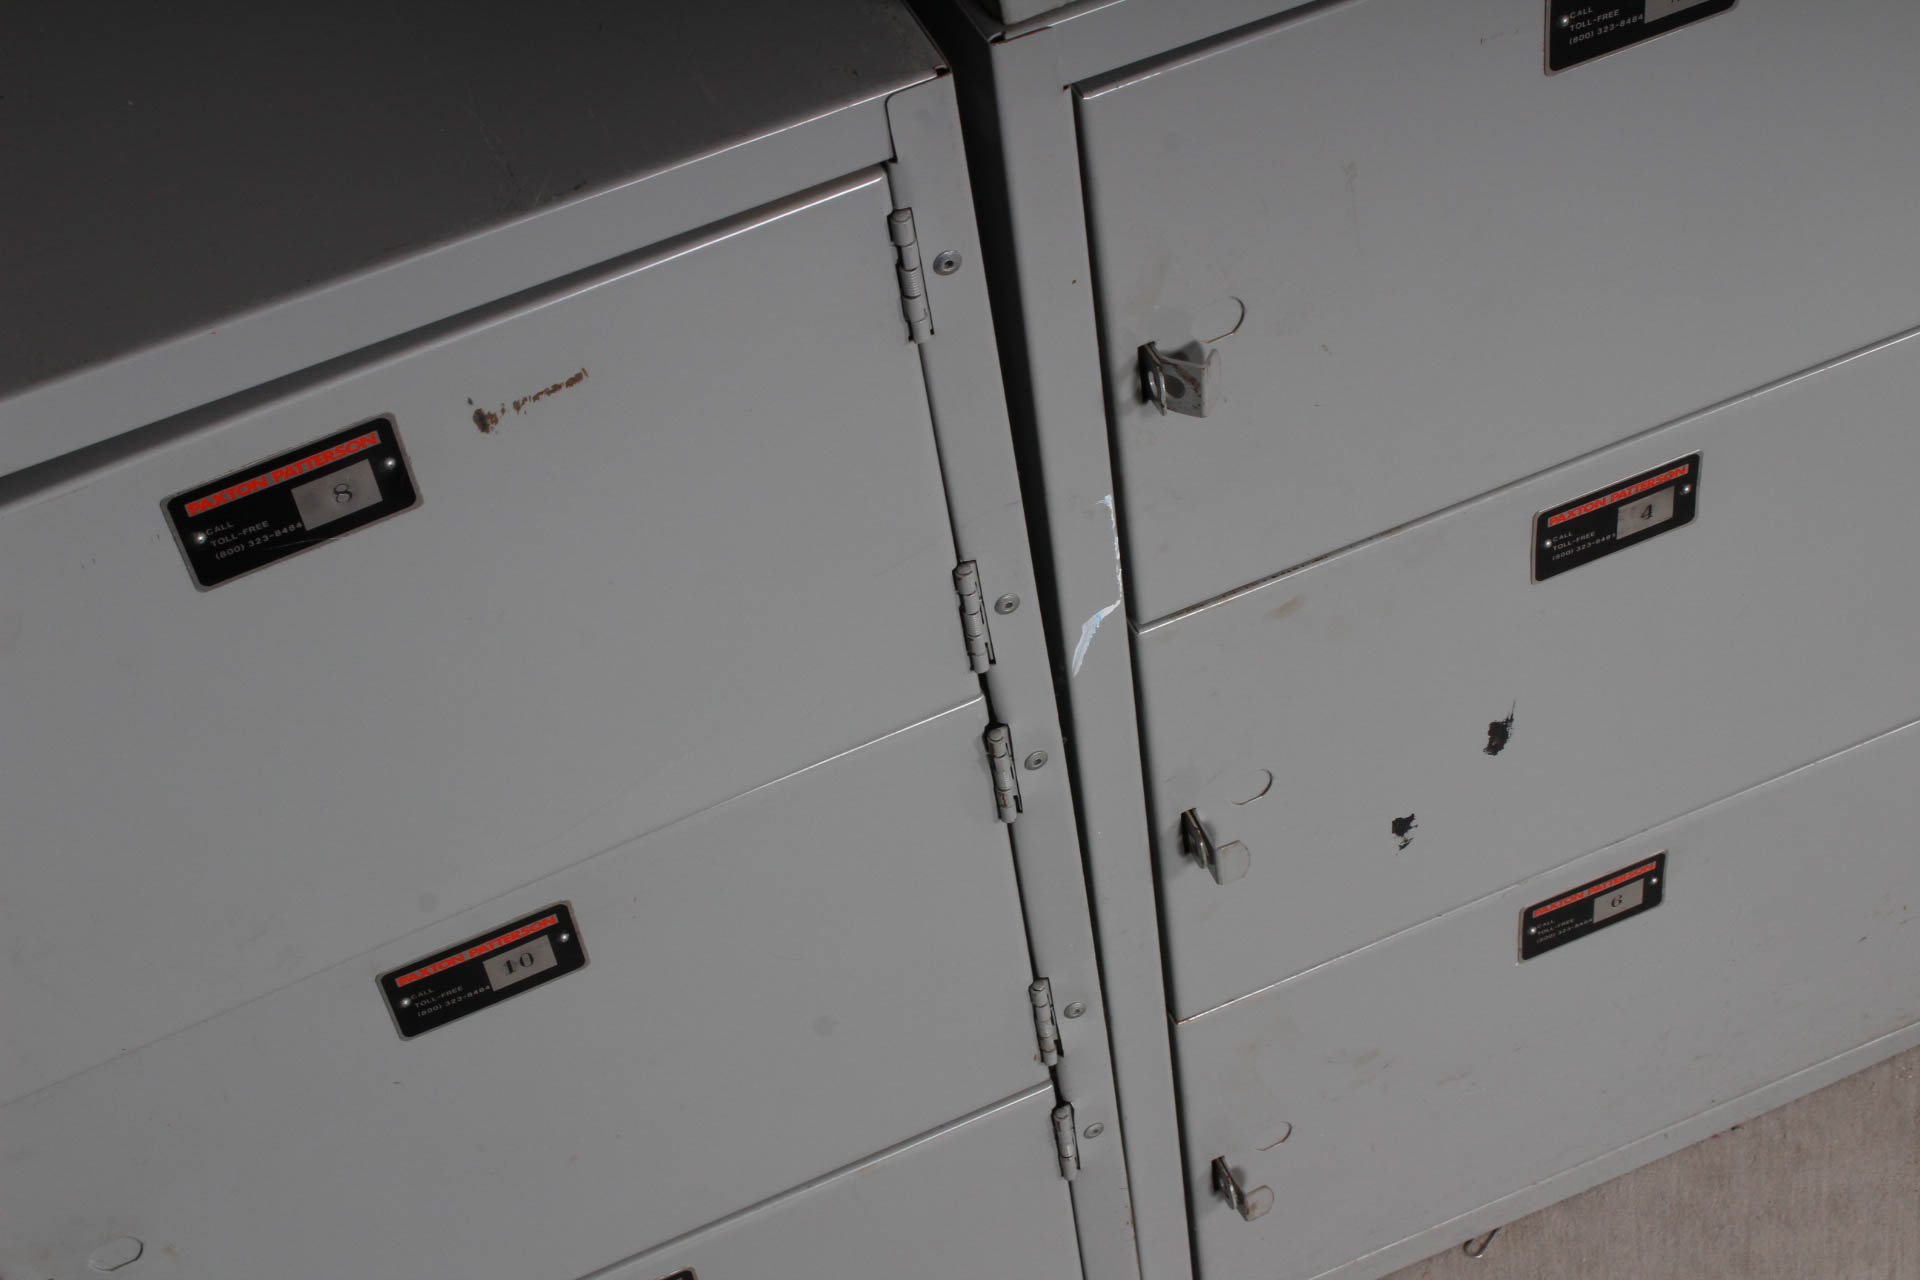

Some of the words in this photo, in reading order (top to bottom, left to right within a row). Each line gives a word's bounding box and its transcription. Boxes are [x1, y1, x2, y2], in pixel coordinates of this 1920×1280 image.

[1569, 7, 1593, 20] CALL
[1569, 9, 1620, 32] TOLL-FREE
[1569, 31, 1595, 46] (800)
[1597, 13, 1644, 36] 323-8484
[186, 476, 269, 517] PAXTON
[271, 432, 379, 484] PATTERSON
[333, 483, 352, 504] 8
[1548, 497, 1608, 527] PAXTON
[1610, 465, 1689, 502] PATTERSON
[1640, 504, 1653, 520] 4
[206, 521, 234, 536] CALL
[210, 520, 270, 548] TOLL-FREE
[1552, 531, 1574, 543] CALL
[215, 544, 246, 561] (800)
[248, 521, 303, 549] 323-8484
[1552, 531, 1596, 552] TOLL-FREE
[1533, 891, 1585, 918] PAXTON
[1611, 895, 1623, 908] 6
[395, 954, 465, 987] PAXTON
[468, 915, 558, 958] PATTERSON
[503, 952, 534, 976] 10
[410, 988, 435, 1000] CALL
[414, 985, 464, 1009] TOLL-FREE
[417, 1004, 443, 1017] (800)
